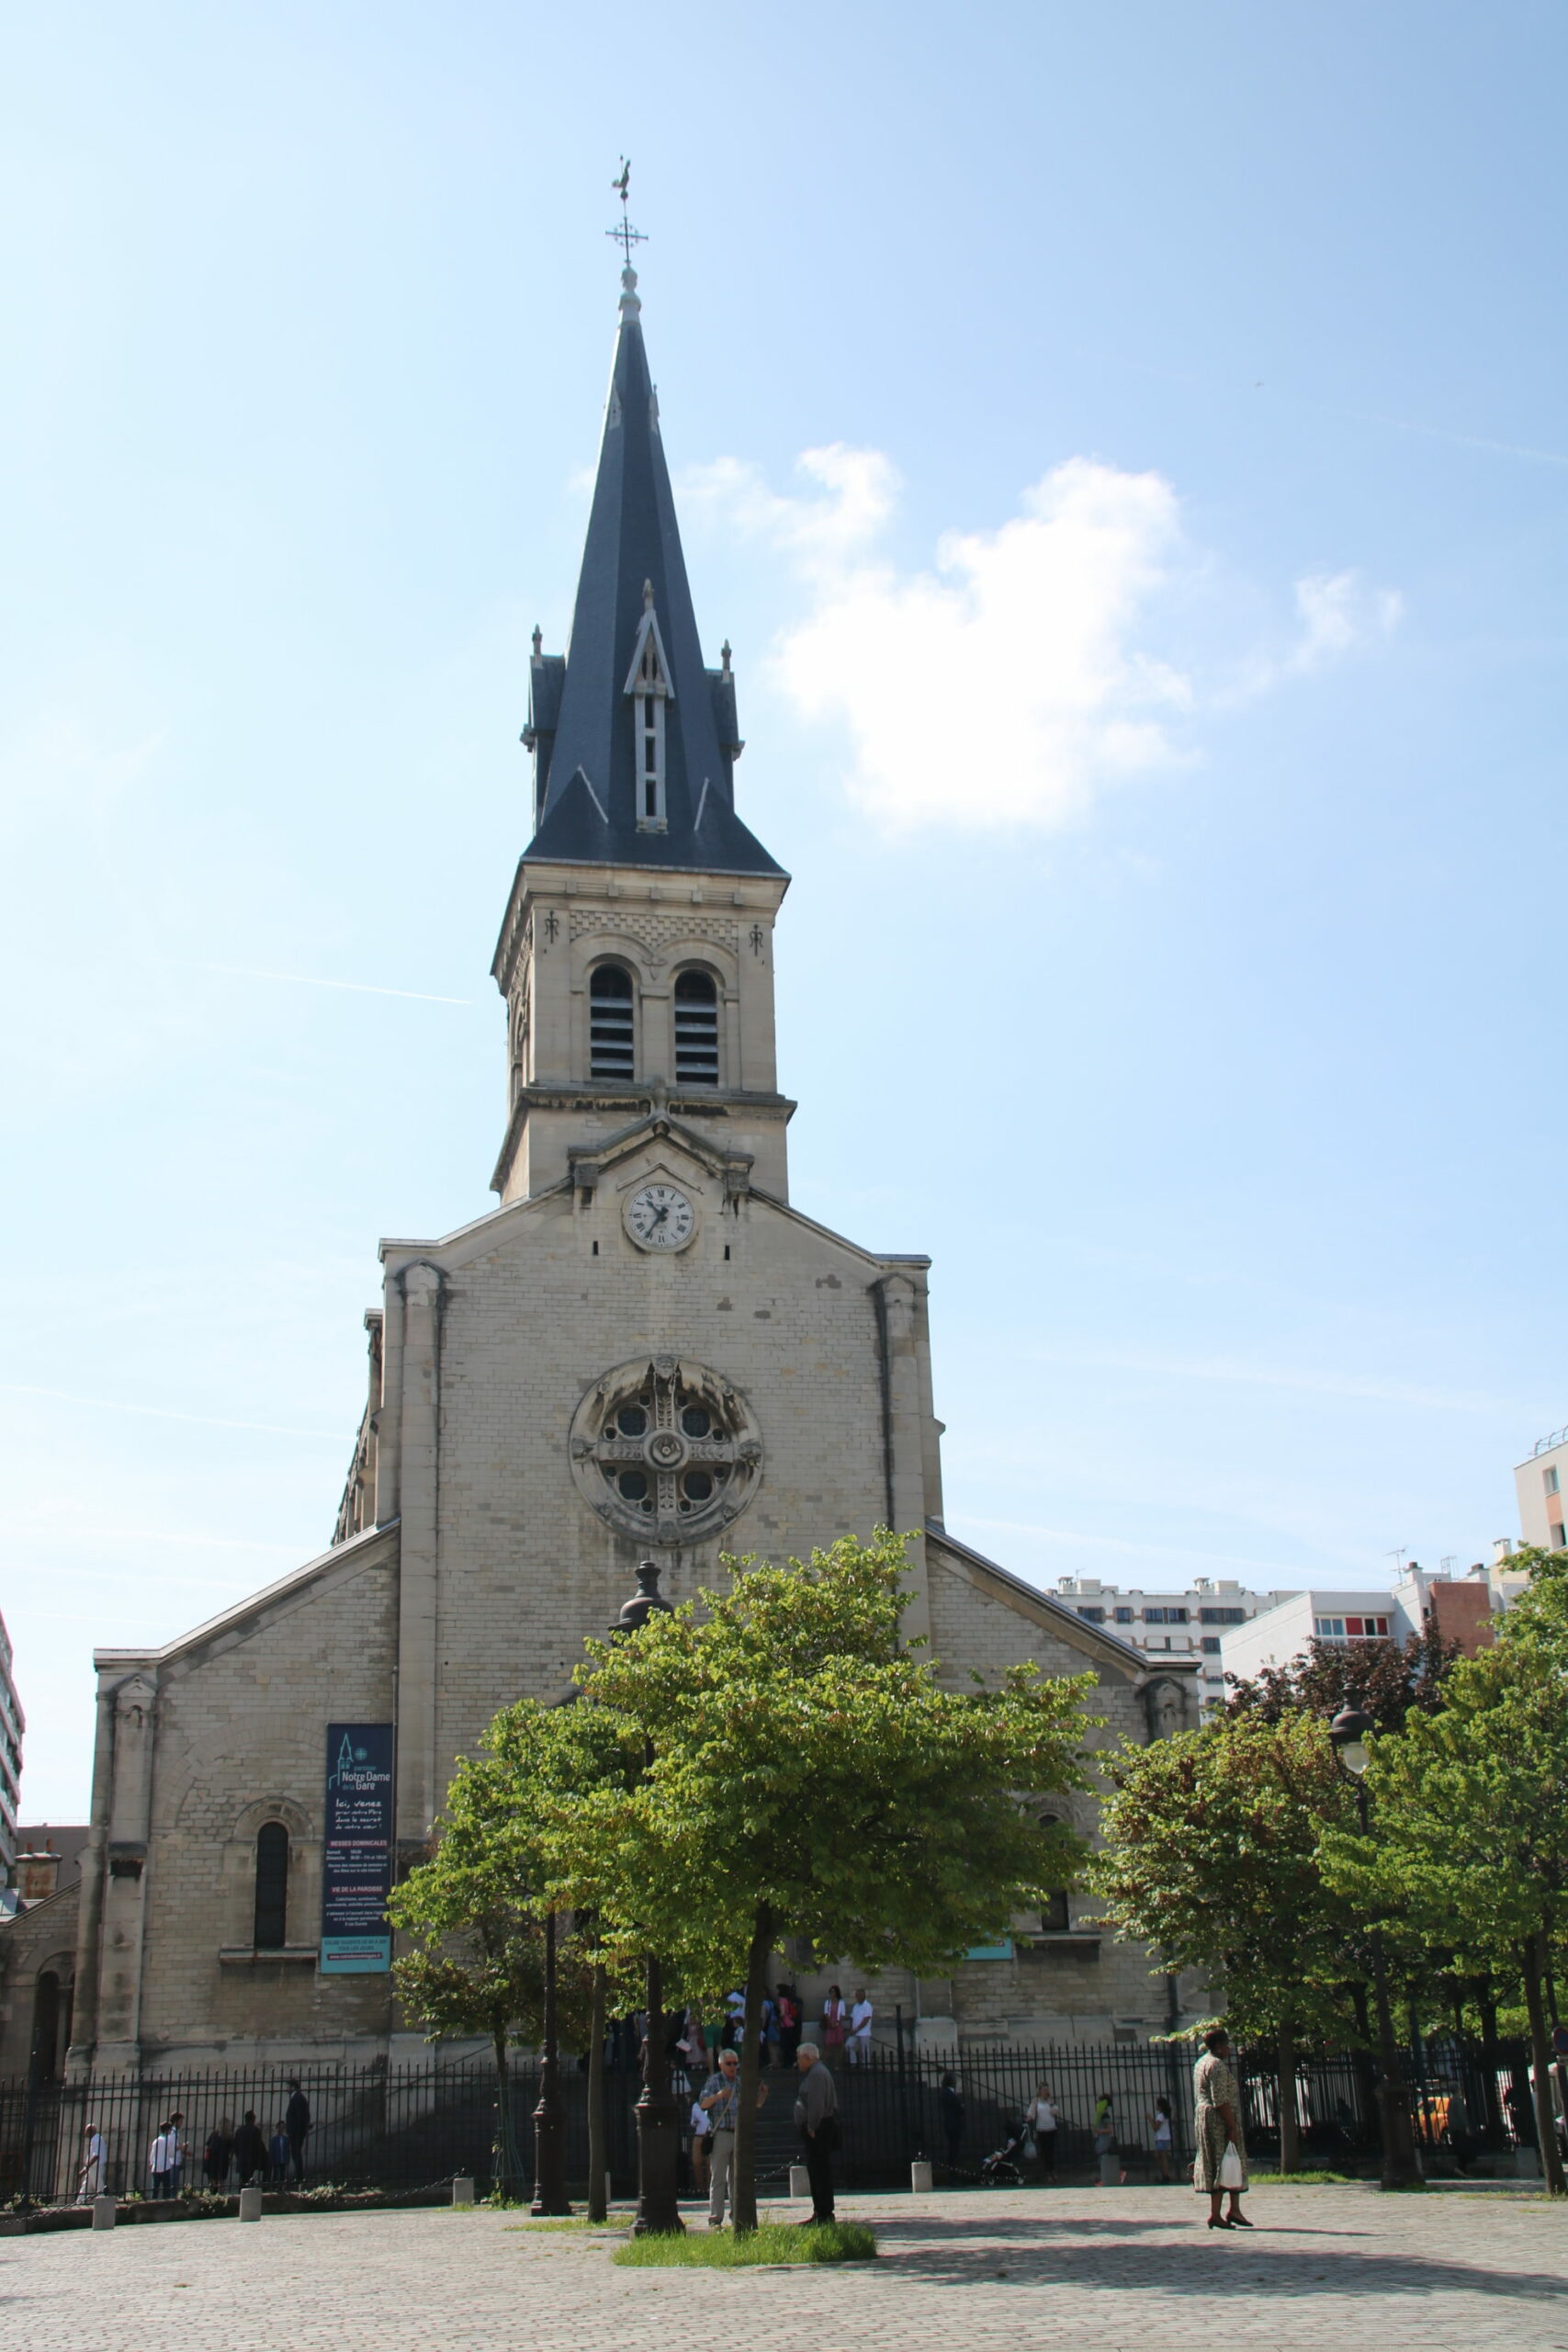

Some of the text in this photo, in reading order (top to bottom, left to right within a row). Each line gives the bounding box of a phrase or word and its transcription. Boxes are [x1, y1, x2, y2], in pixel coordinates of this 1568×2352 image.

[342, 1770, 389, 1781] Notre Dame
[355, 1780, 375, 1790] Gare
[336, 1798, 350, 1808] Ici,
